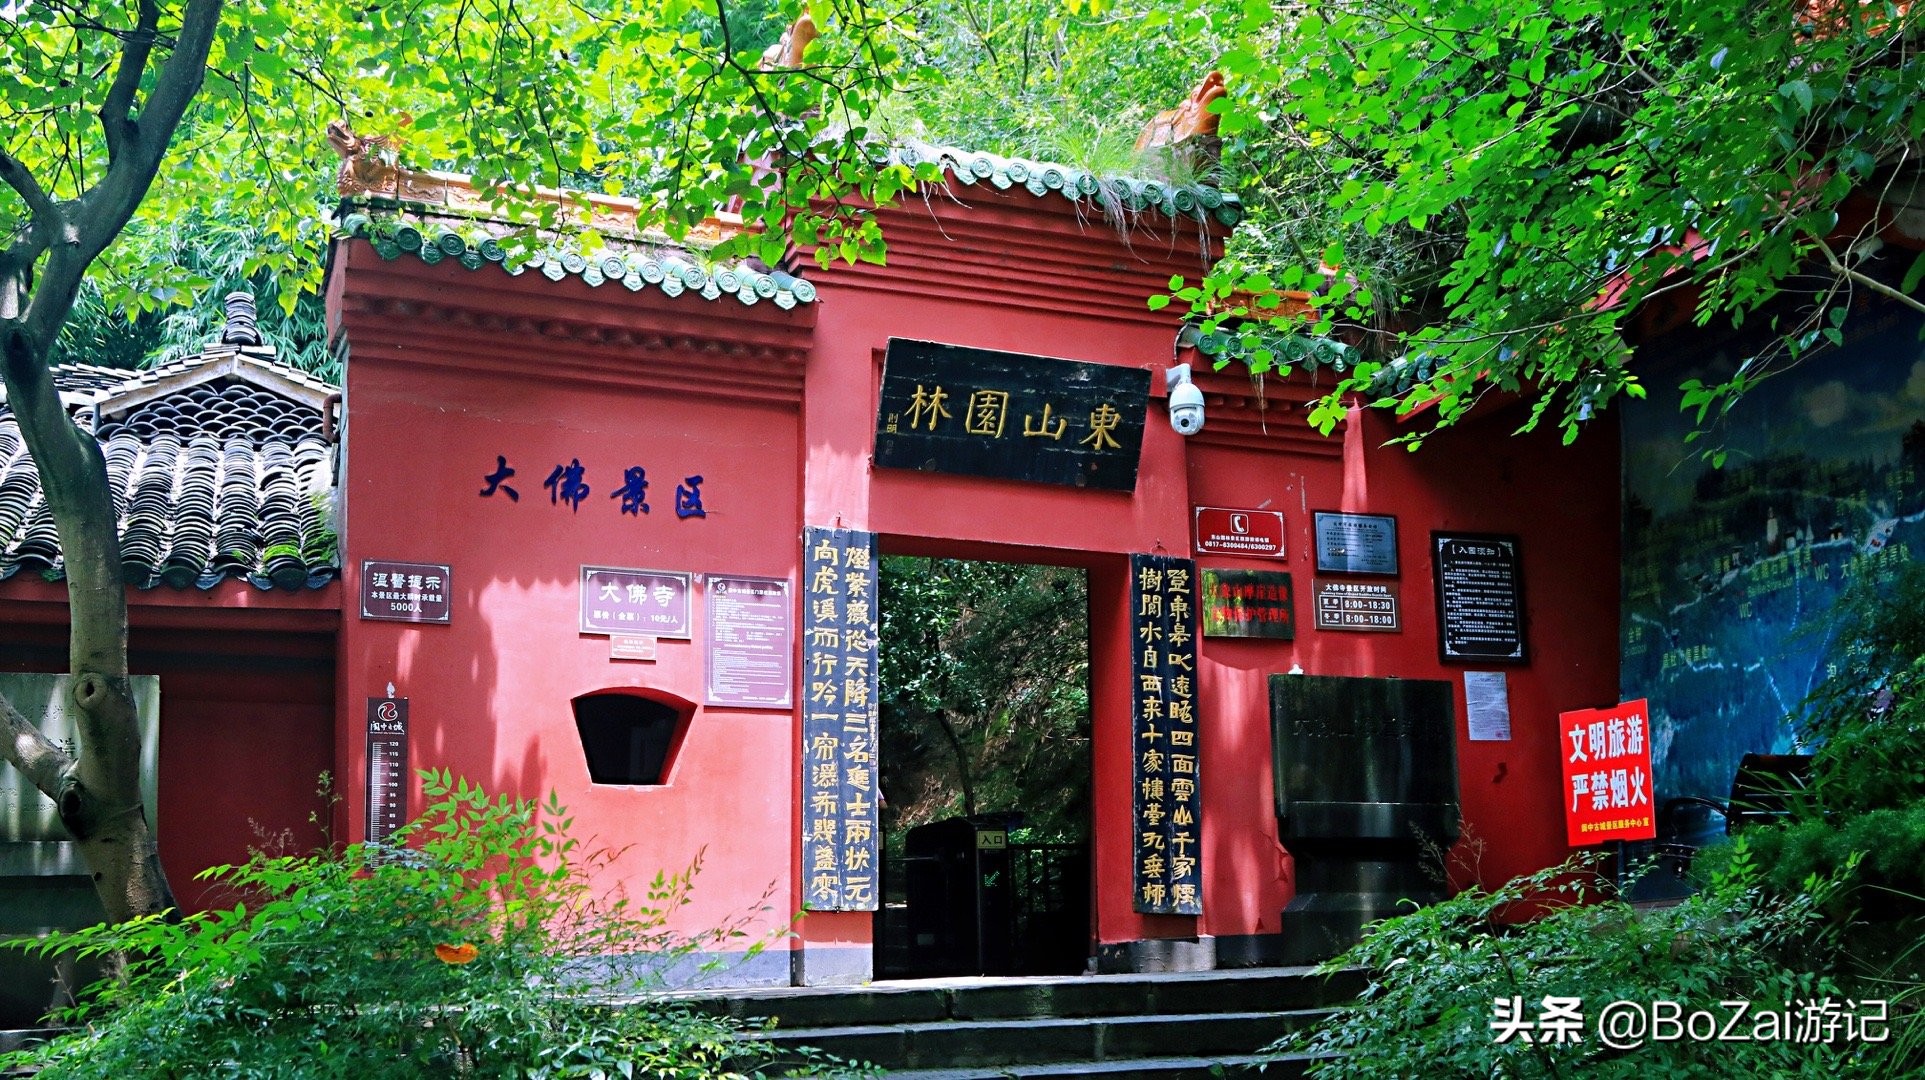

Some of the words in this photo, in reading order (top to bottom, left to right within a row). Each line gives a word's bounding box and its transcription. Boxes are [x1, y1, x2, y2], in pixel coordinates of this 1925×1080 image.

[904, 384, 1122, 450] 東山園林
[480, 455, 707, 519] 大佛景区
[1814, 562, 1830, 581] WC
[373, 572, 441, 590] 温馨提示
[1325, 584, 1387, 594] 大佛寺景区开放时间
[598, 581, 676, 607] 大佛寺
[390, 602, 422, 613] 5000人
[1344, 599, 1391, 610] 8:00-18:30
[1345, 614, 1392, 625] 8:00-18:00
[1568, 714, 1644, 763] 文明旅游
[1571, 766, 1648, 813] 严禁烟火
[982, 834, 1003, 845] 入口
